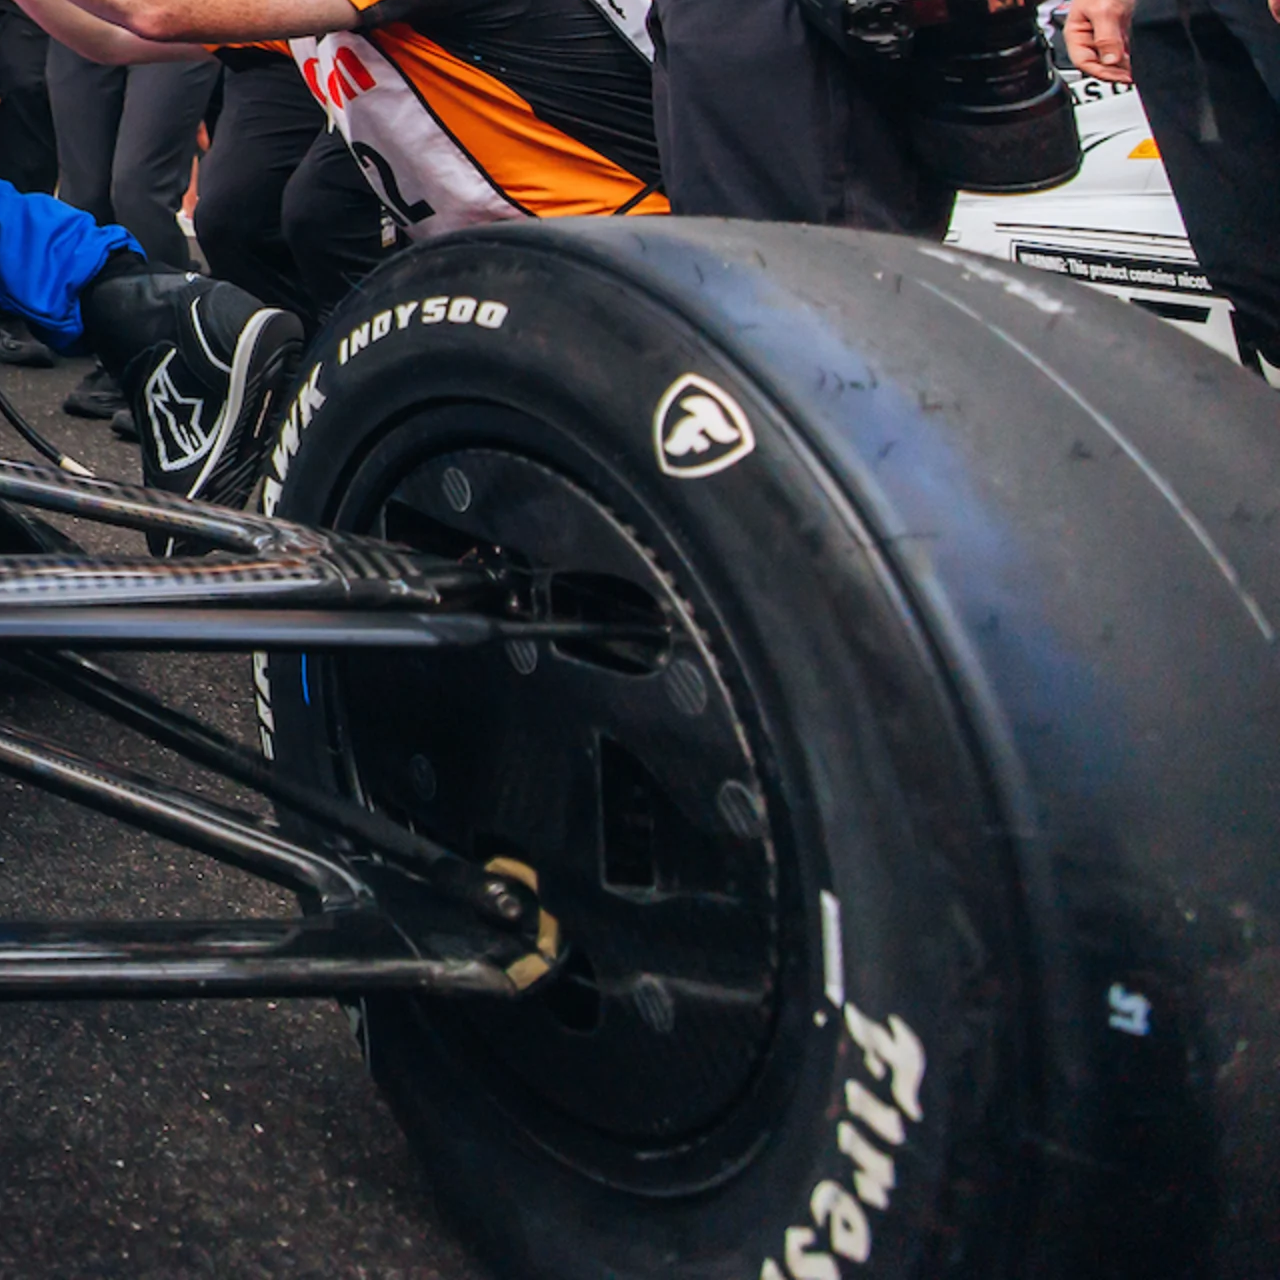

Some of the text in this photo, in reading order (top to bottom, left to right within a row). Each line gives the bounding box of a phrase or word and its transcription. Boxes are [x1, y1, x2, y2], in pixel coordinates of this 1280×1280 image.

[1066, 259, 1089, 276] This
[1089, 263, 1129, 281] product
[1129, 268, 1177, 286] contains
[340, 296, 510, 365] INDY 500
